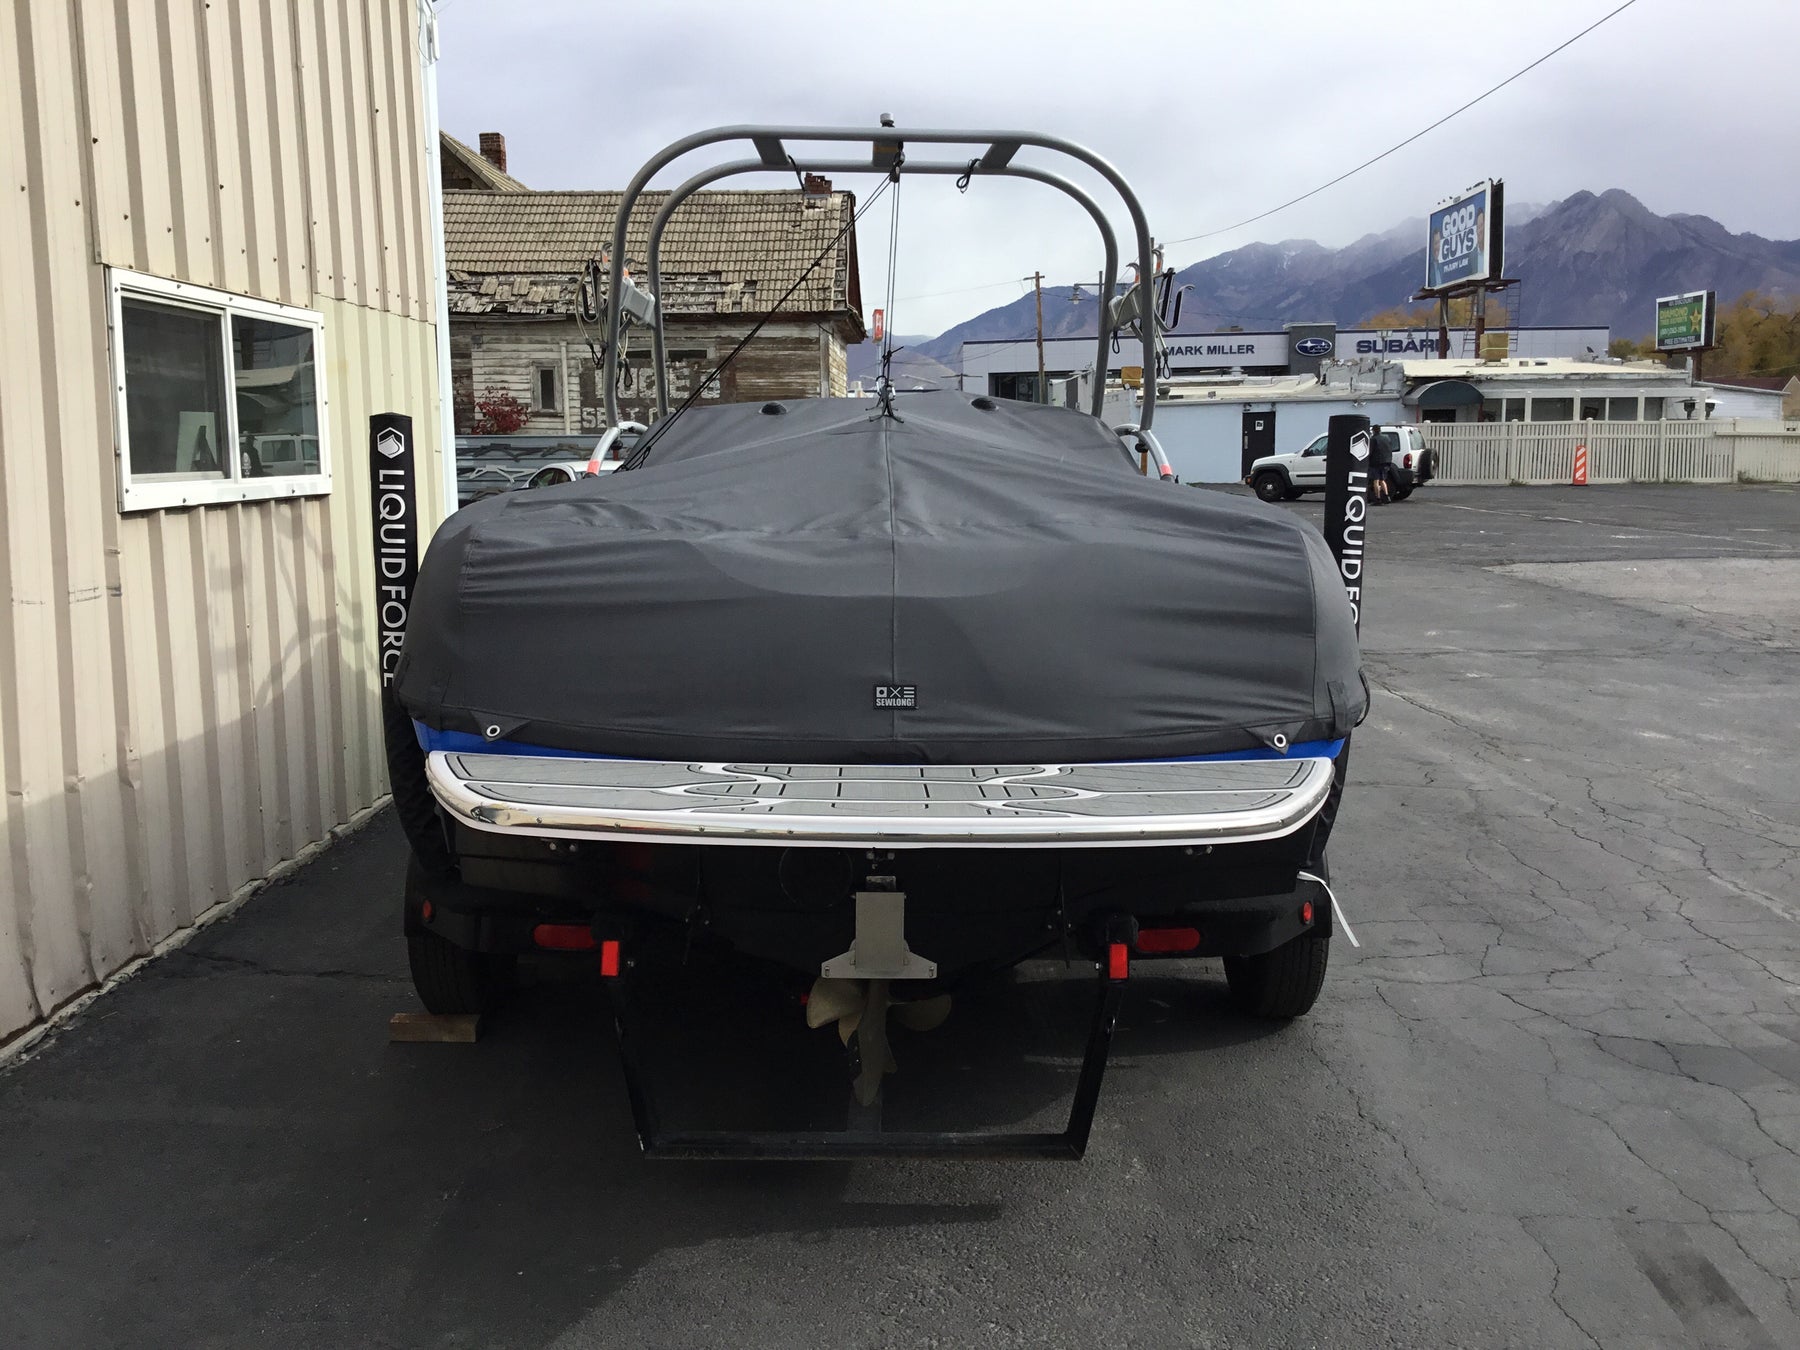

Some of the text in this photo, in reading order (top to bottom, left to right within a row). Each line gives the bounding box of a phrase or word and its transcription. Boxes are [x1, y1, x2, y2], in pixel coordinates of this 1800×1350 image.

[1443, 204, 1475, 238] GOOD
[1442, 228, 1475, 261] GUYS
[1167, 344, 1255, 356] MARK MILLER
[379, 469, 407, 579] LIQUID
[1340, 471, 1368, 580] LIQUID
